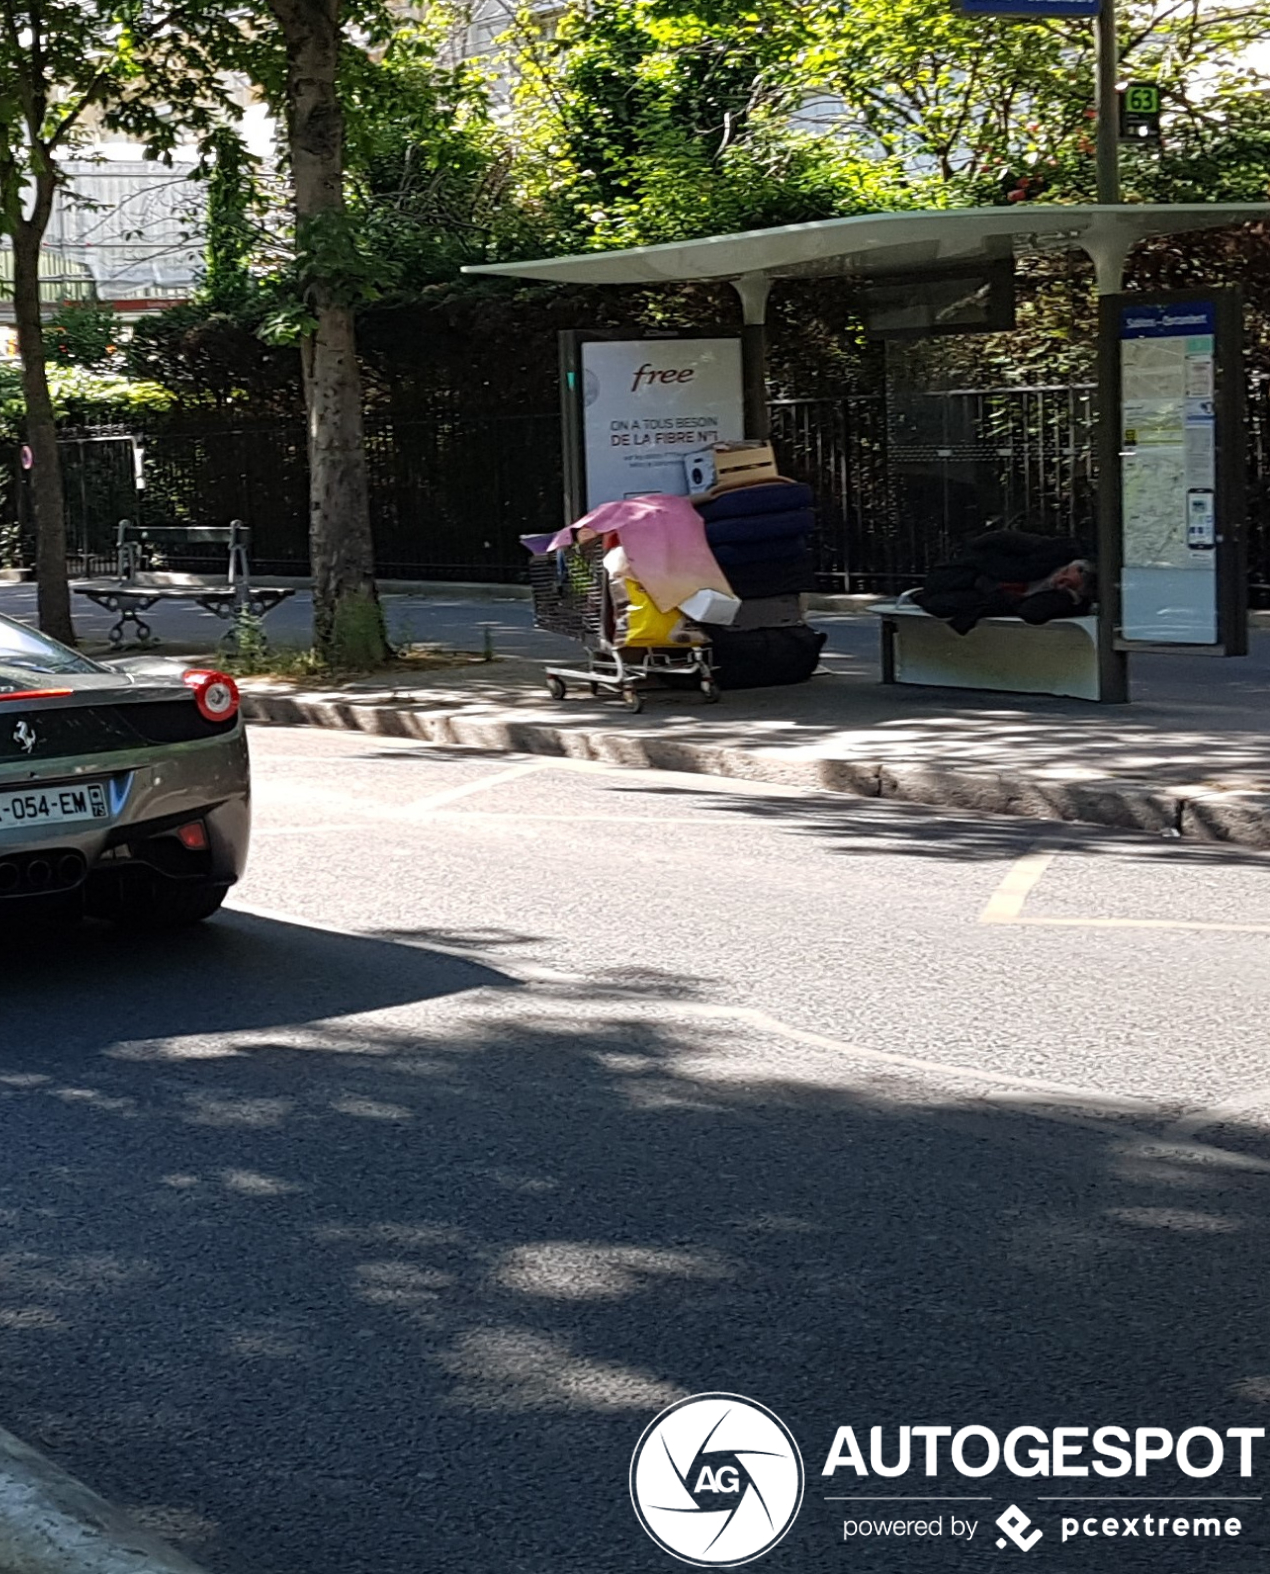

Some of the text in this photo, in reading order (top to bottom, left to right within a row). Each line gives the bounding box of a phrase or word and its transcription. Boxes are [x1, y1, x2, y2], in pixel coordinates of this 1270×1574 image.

[1131, 89, 1153, 110] 63
[630, 363, 695, 392] free
[610, 417, 718, 431] ON A TOUS BESOIN
[611, 434, 630, 446] DE
[633, 433, 651, 445] LA
[655, 431, 694, 444] FIBRE
